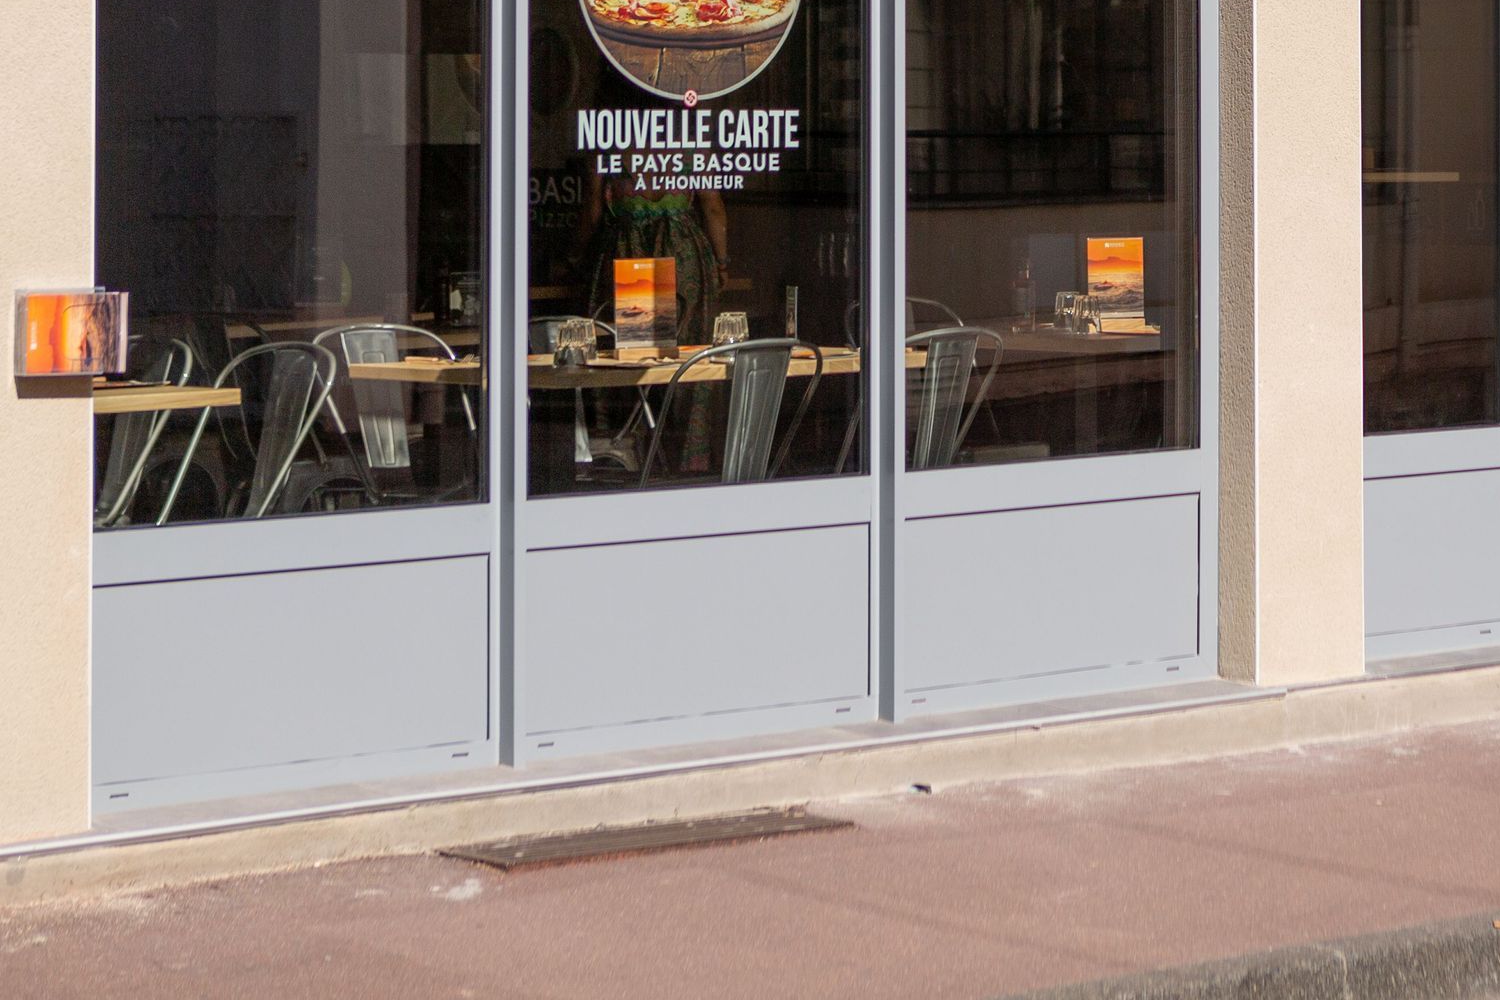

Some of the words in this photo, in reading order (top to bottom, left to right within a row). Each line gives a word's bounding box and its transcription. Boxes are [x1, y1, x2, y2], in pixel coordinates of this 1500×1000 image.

[577, 109, 711, 150] NOUVELLE
[718, 109, 800, 149] CARTE
[597, 154, 621, 174] LE
[631, 153, 684, 173] PAYS
[693, 152, 780, 173] BASQUE
[635, 172, 647, 191] À
[652, 174, 744, 191] L'HONNEUR
